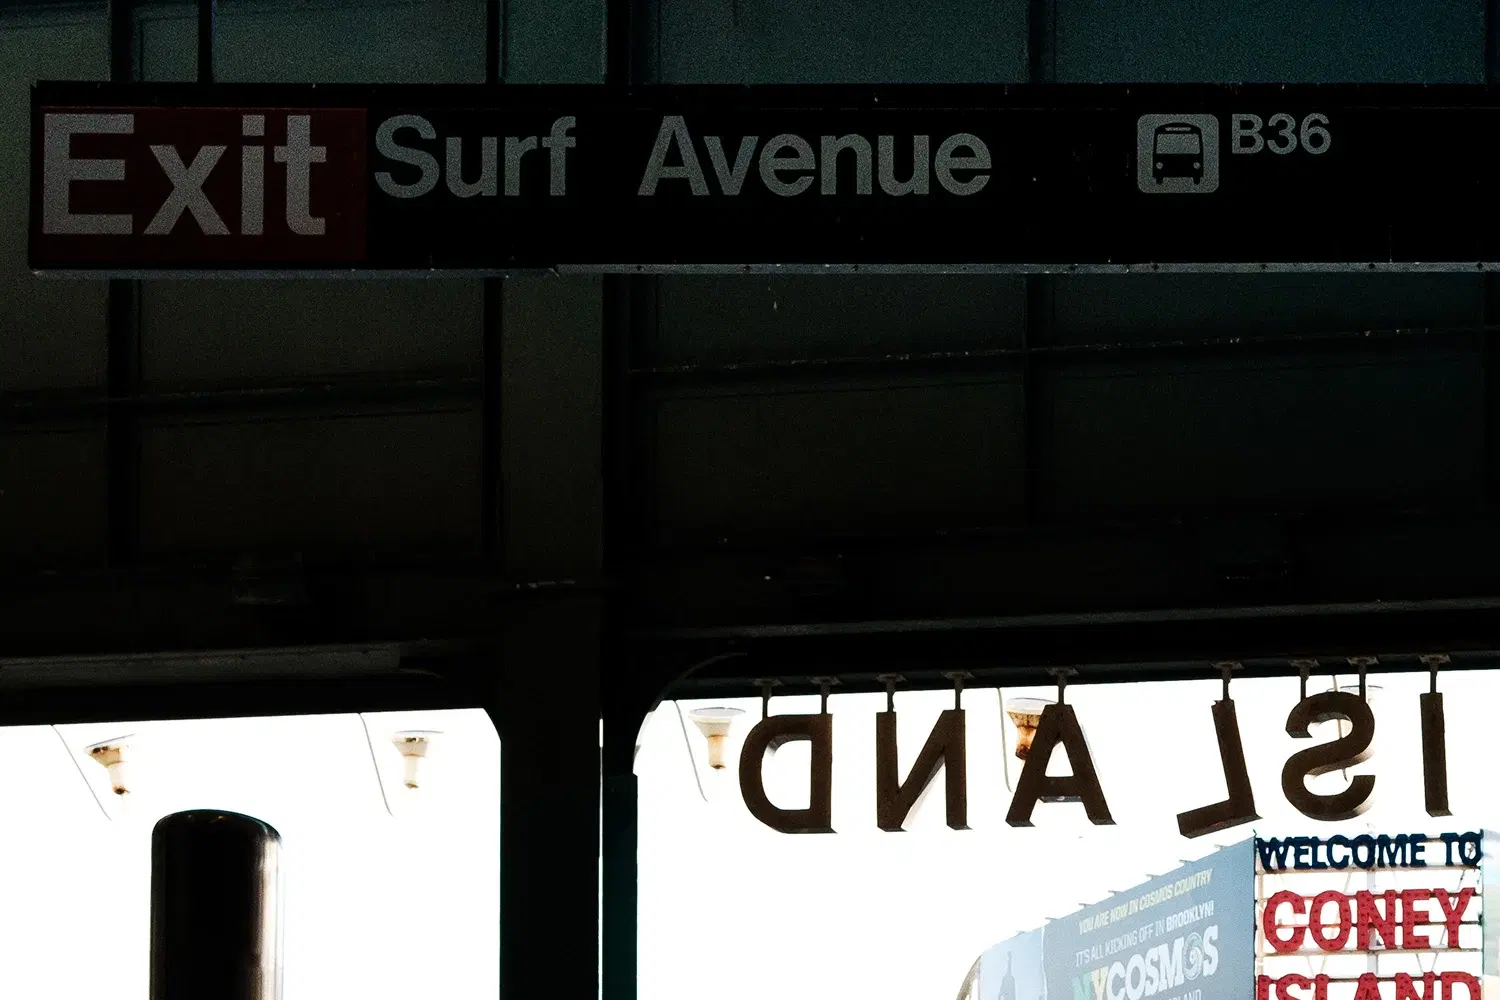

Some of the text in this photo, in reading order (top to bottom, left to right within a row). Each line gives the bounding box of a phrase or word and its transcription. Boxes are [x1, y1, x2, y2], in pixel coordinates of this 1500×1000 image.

[374, 113, 993, 199] Surf Avenue
[1231, 113, 1331, 155] B36
[43, 113, 326, 236] Exit
[1256, 831, 1483, 873] WELCOME TO
[1079, 868, 1213, 935] YOU ARE NOW IN COSMOS COUNTRY
[1091, 942, 1104, 960] ALL
[1105, 929, 1138, 955] KICKING
[1139, 922, 1153, 943] OFF
[1154, 918, 1165, 937] IN
[1166, 900, 1215, 933] BROOKLYN!
[1263, 887, 1476, 953] CONEY
